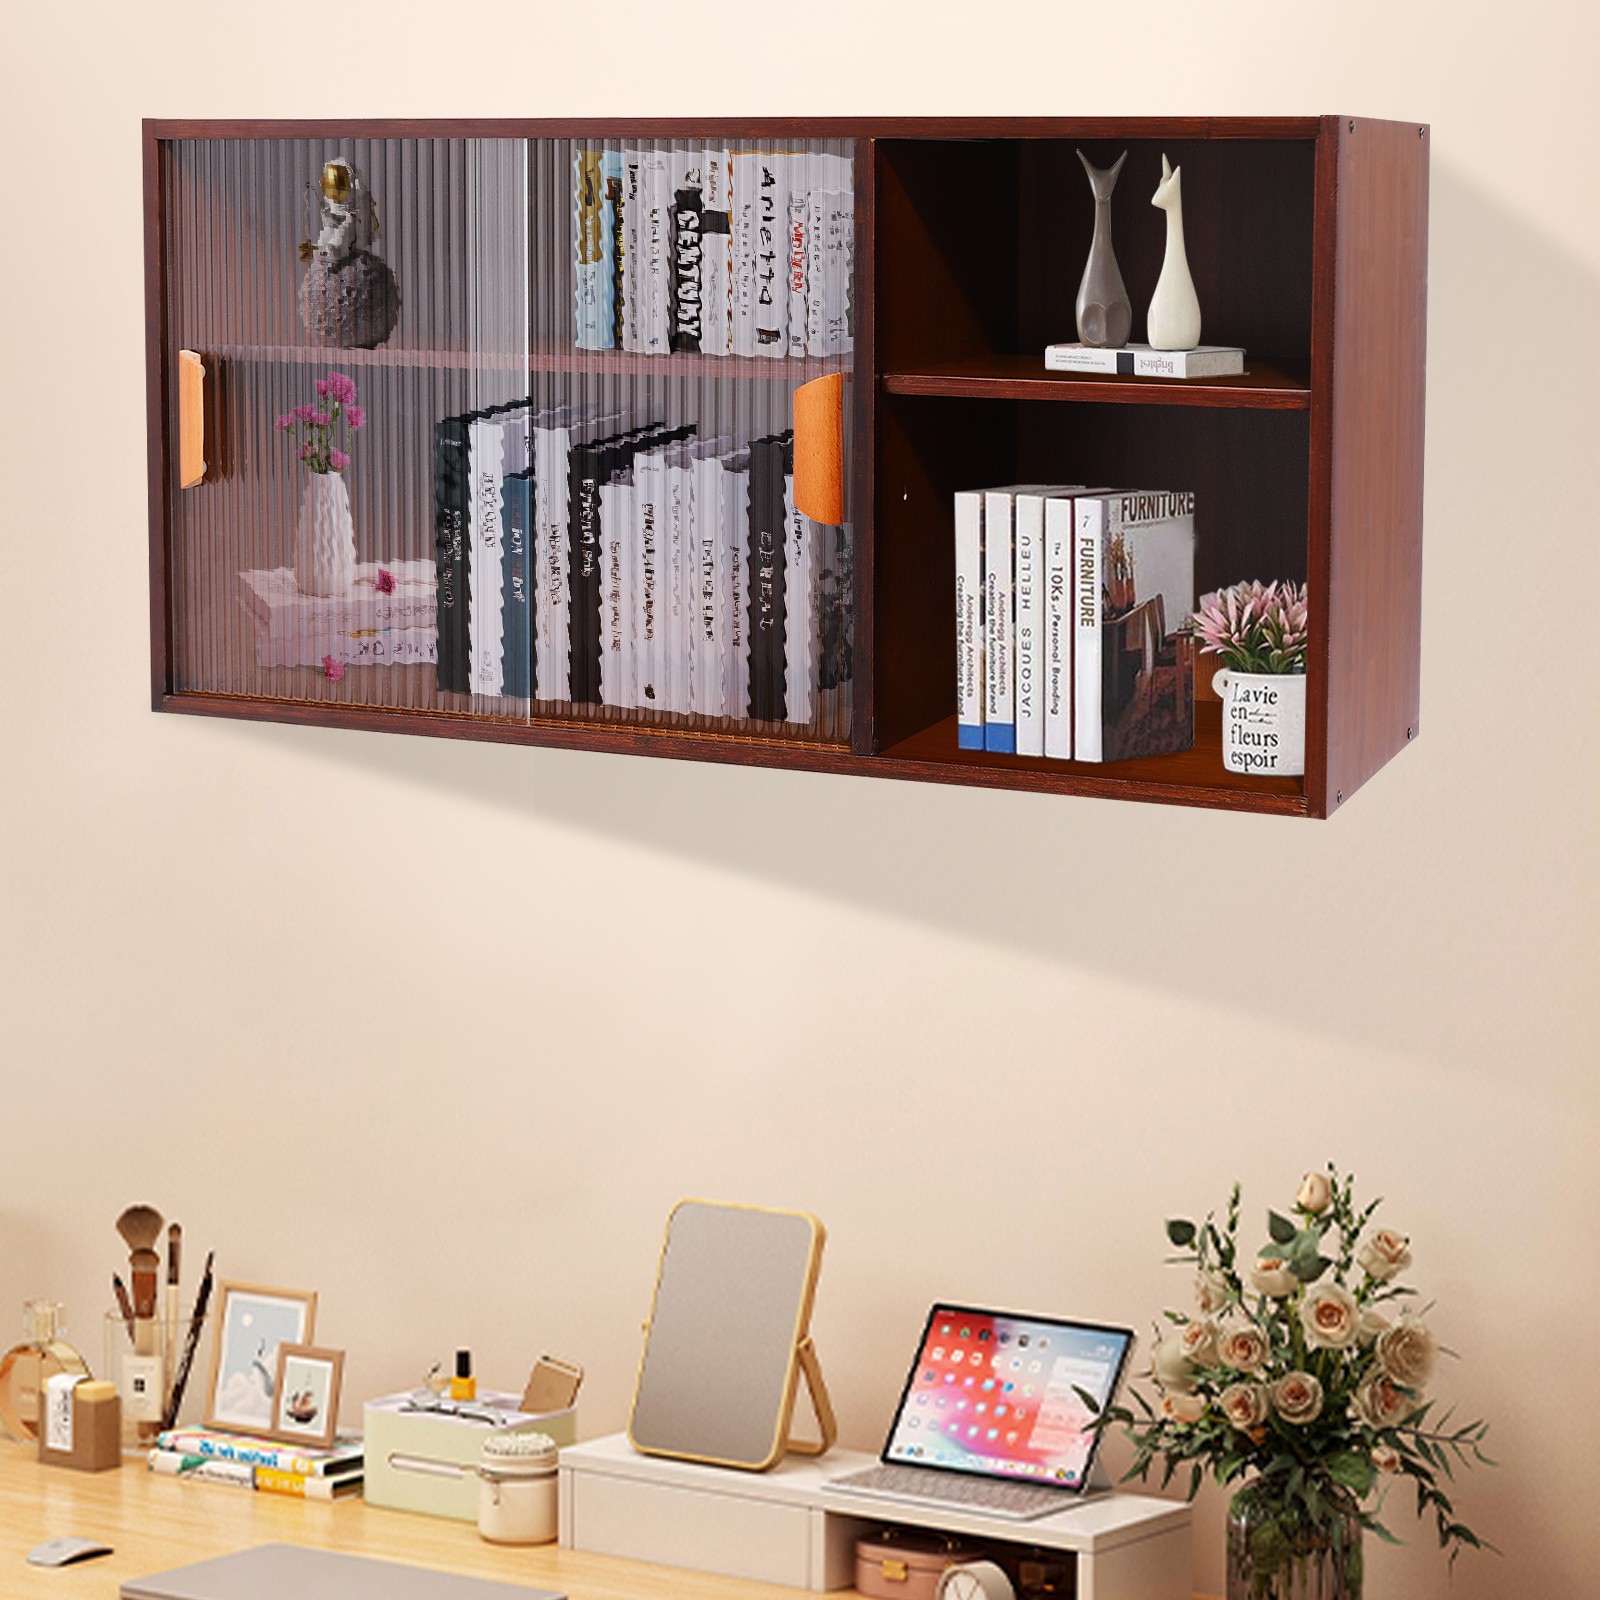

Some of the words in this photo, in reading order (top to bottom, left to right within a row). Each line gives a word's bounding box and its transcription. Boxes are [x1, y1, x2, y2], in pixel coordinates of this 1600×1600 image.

[1139, 357, 1174, 374] Brightest
[1121, 493, 1194, 522] FURNITURE
[988, 572, 997, 616] Creating
[1021, 535, 1031, 610] HELLEU
[1051, 565, 1064, 602] 10Ks
[1080, 537, 1096, 628] FURNITURE
[957, 575, 966, 618] Creating
[997, 591, 1007, 641] Anderegg
[957, 620, 966, 637] the
[965, 594, 975, 644] Anderegg
[988, 618, 997, 635] the
[1050, 613, 1062, 663] Personal
[957, 639, 966, 683] furniture
[966, 646, 975, 698] Architects
[988, 637, 997, 681] furniture
[998, 644, 1007, 696] Architects
[1020, 627, 1032, 718] JACQUES
[957, 685, 966, 716] brand
[989, 683, 997, 714] brand
[1049, 667, 1062, 716] Branding
[1230, 706, 1248, 721] en
[1230, 724, 1279, 748] fleurs
[1230, 749, 1279, 772] espoir
